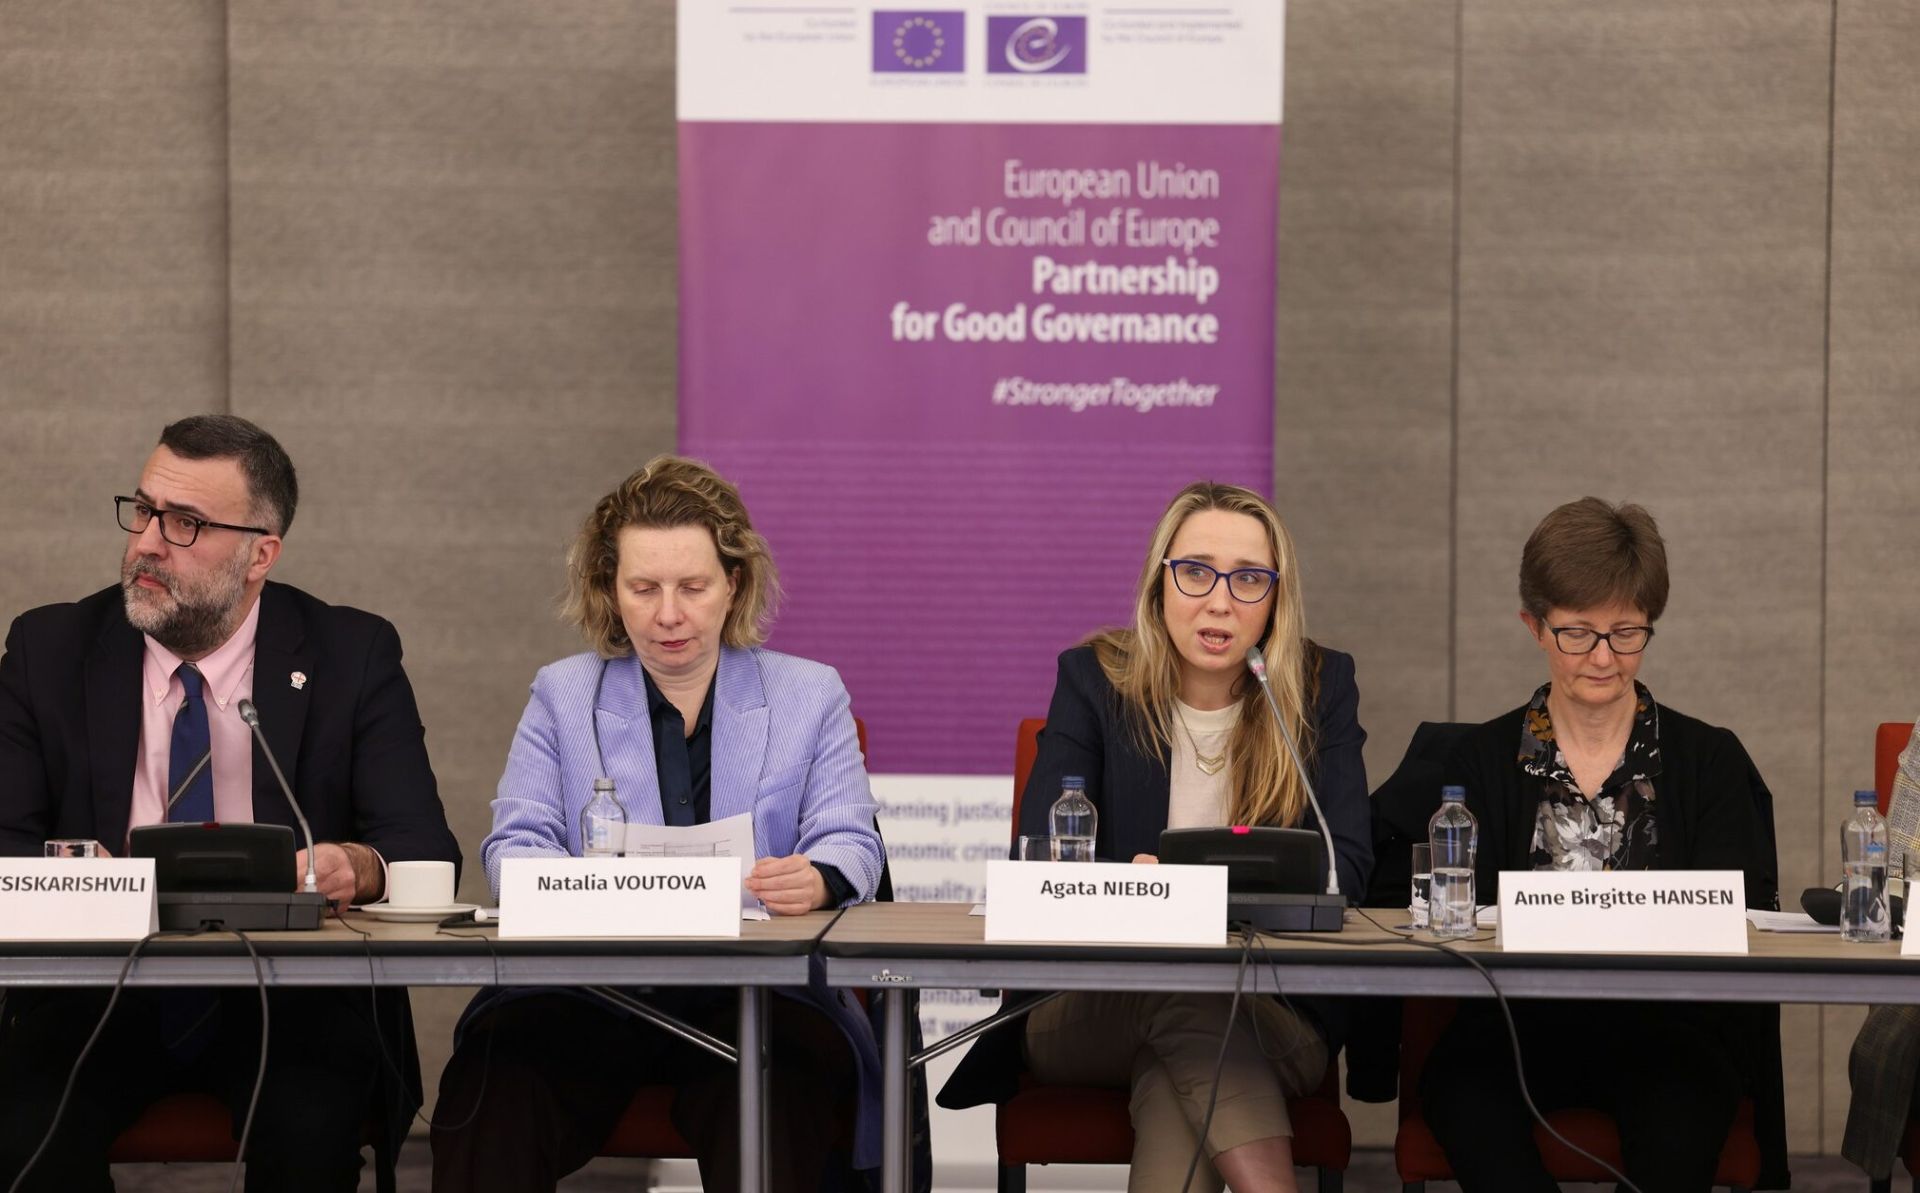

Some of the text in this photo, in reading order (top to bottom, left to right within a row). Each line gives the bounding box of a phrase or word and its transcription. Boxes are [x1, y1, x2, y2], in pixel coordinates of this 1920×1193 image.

[1004, 159, 1220, 206] European Union
[927, 206, 1220, 255] and Council of Europe
[1032, 255, 1220, 304] Partnership
[890, 301, 1220, 343] for Good Governance
[992, 377, 1221, 412] #StrongerTogether
[0, 876, 146, 892] SISKARISHVILI
[538, 873, 707, 891] Natalia VOUTOVA
[1040, 879, 1171, 899] Agata NIEBOJ
[1514, 887, 1734, 909] Anne Birgitte HANSEN
